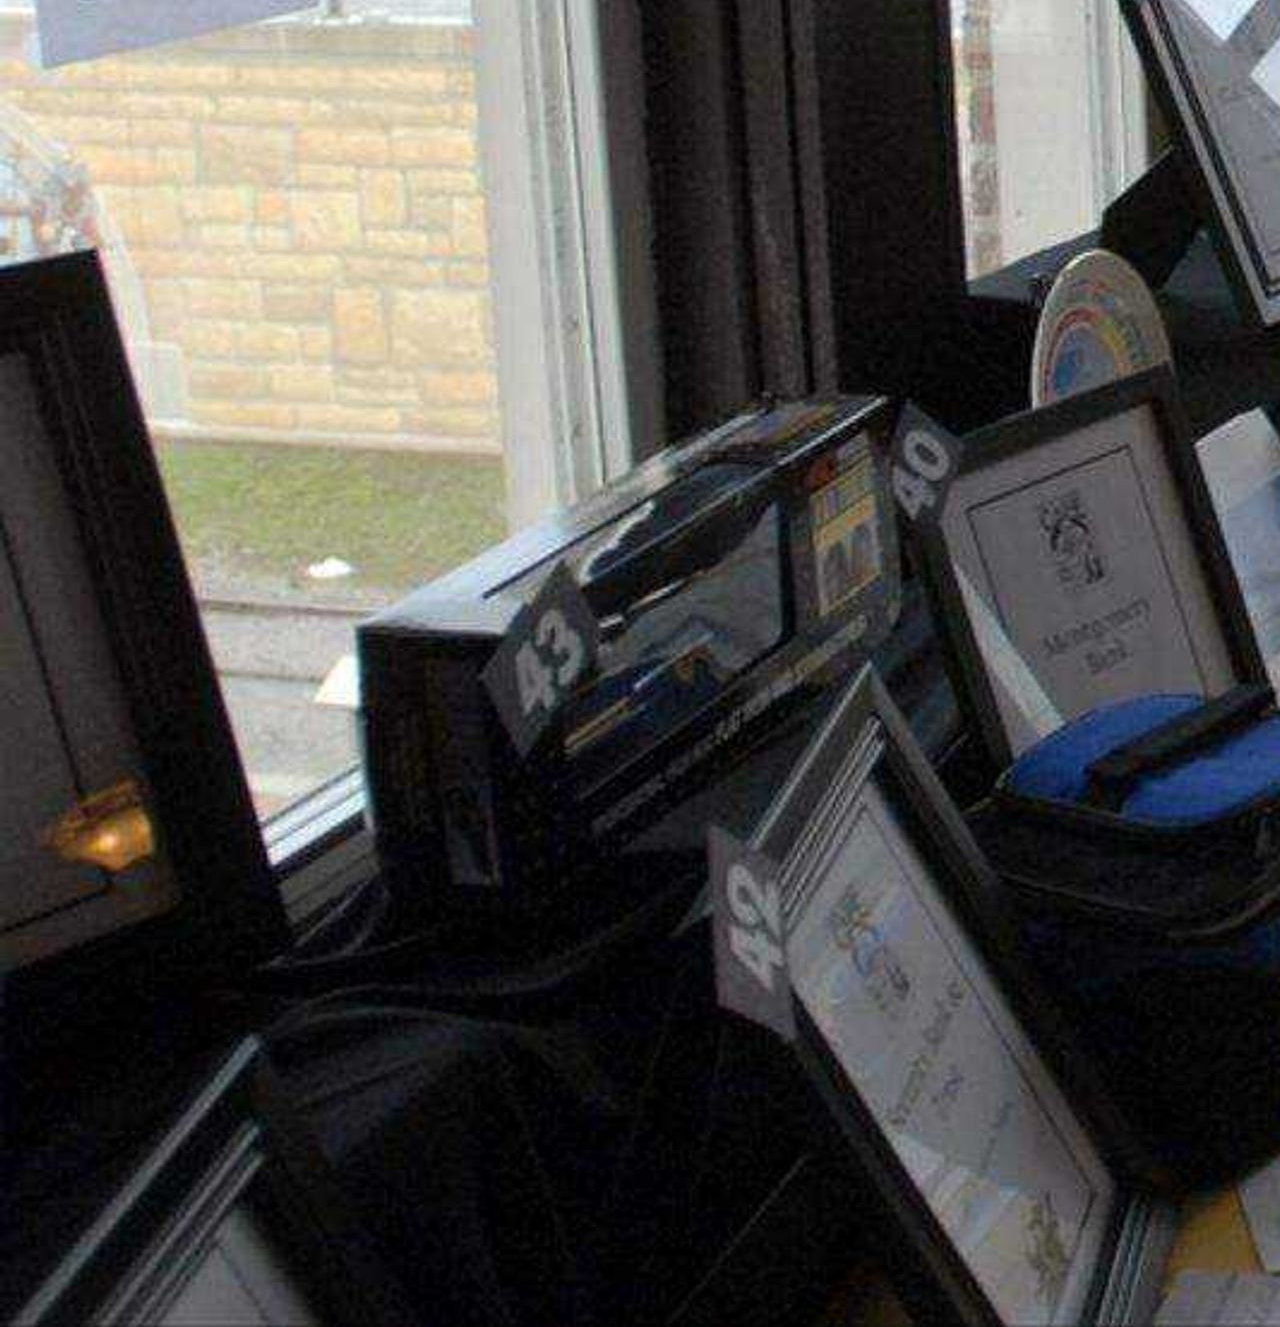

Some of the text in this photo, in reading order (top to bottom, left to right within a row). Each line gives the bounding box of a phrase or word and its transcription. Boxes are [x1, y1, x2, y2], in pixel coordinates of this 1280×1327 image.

[893, 430, 950, 521] 40
[514, 608, 583, 715] 43
[726, 863, 784, 997] 42
